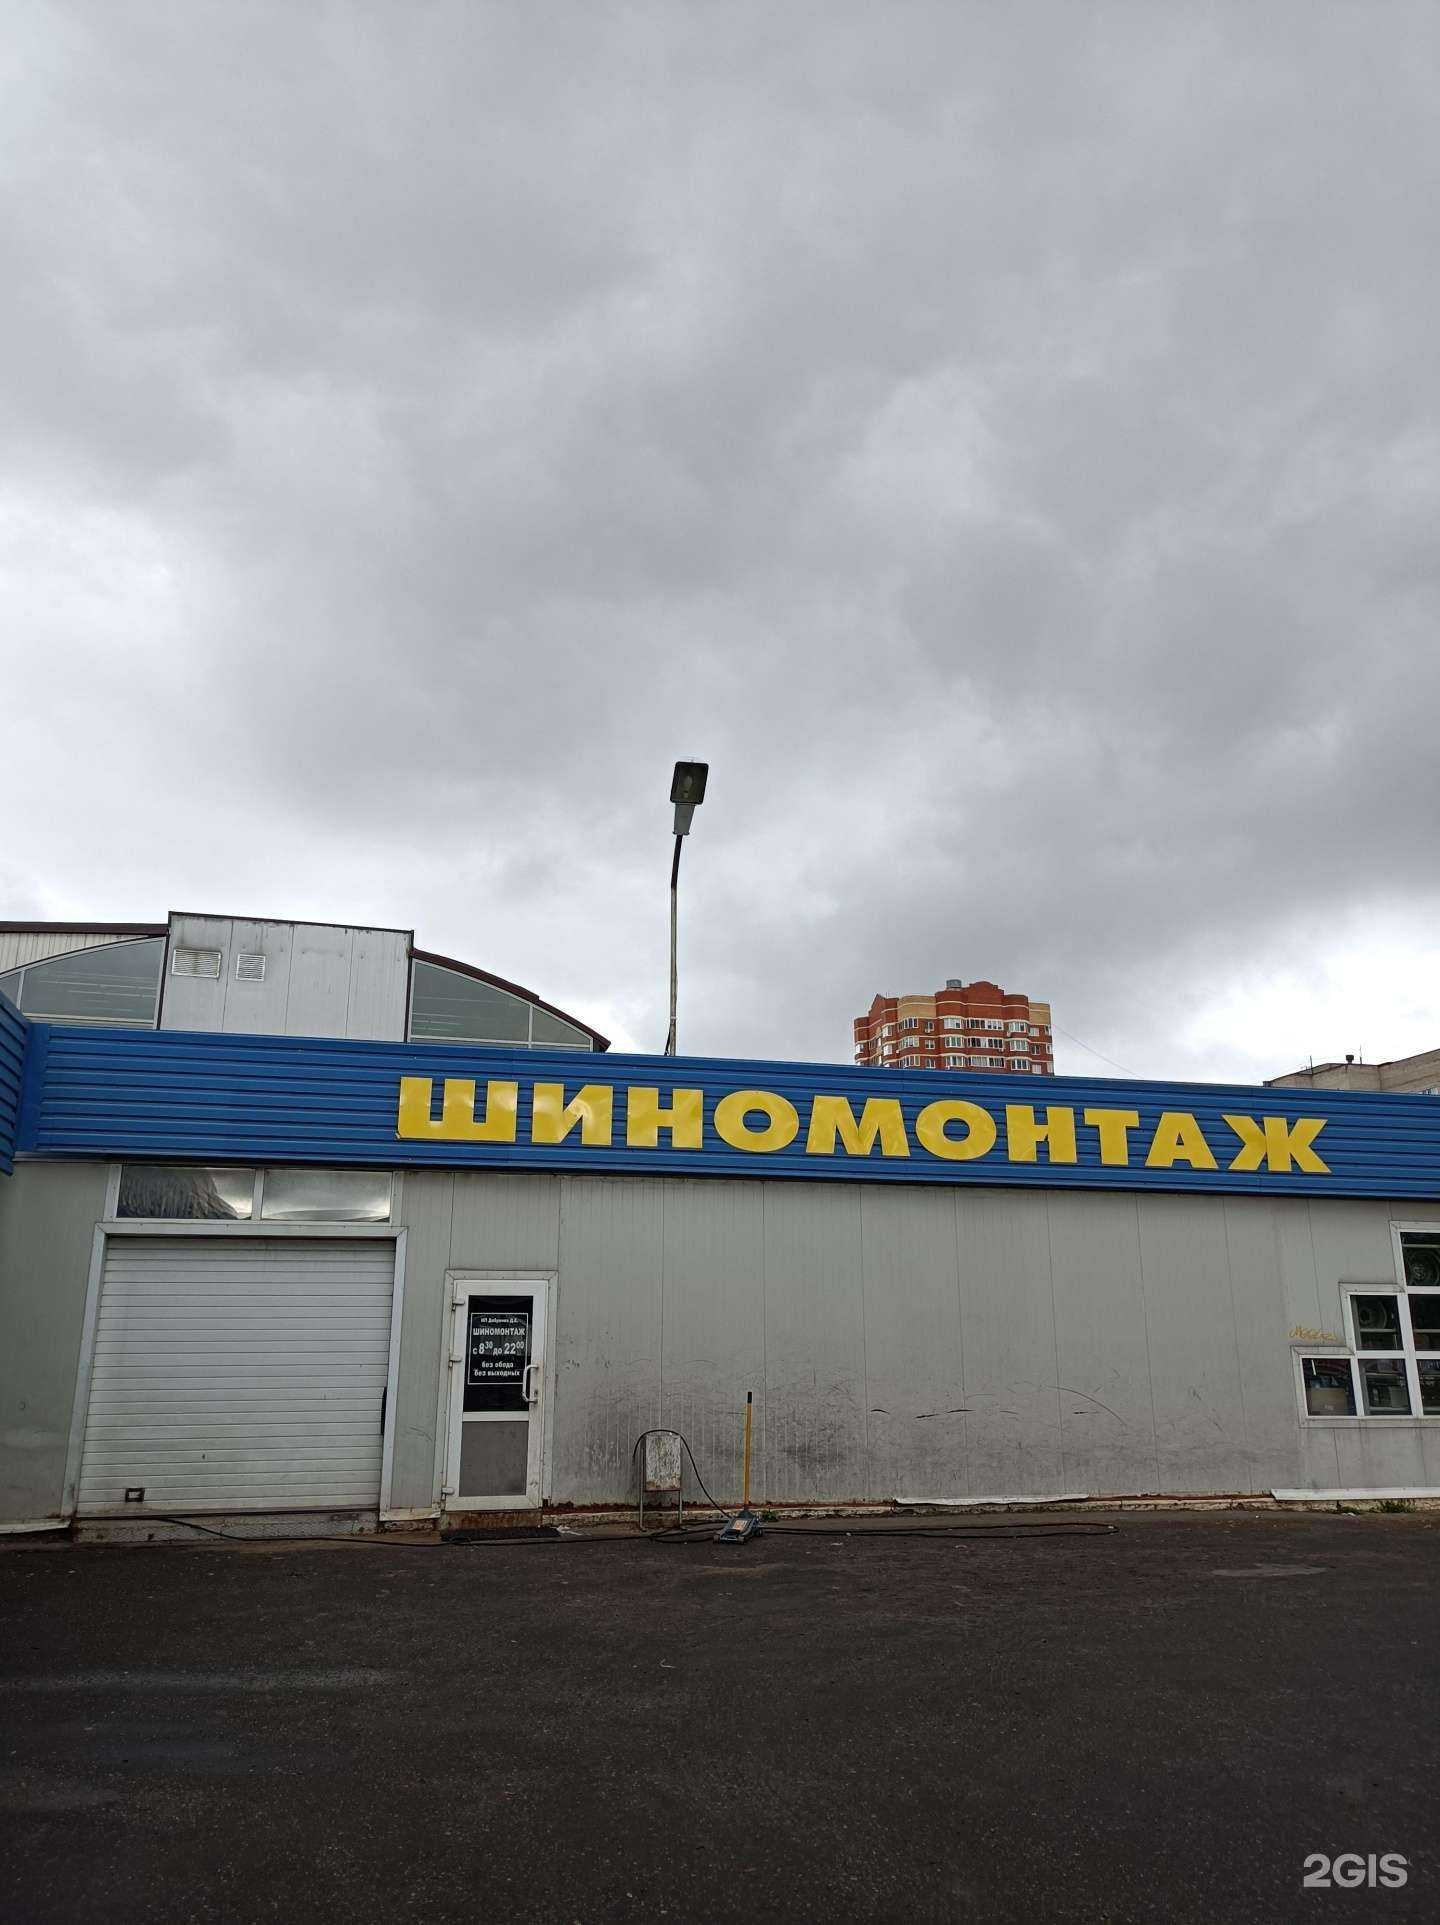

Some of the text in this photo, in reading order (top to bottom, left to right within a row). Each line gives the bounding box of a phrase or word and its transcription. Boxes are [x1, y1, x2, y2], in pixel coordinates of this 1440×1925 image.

[396, 1076, 1332, 1174] ШИНОМОНТАЖ
[473, 1328, 525, 1336] ШИНОМОНТАЖ
[493, 1348, 503, 1356] до
